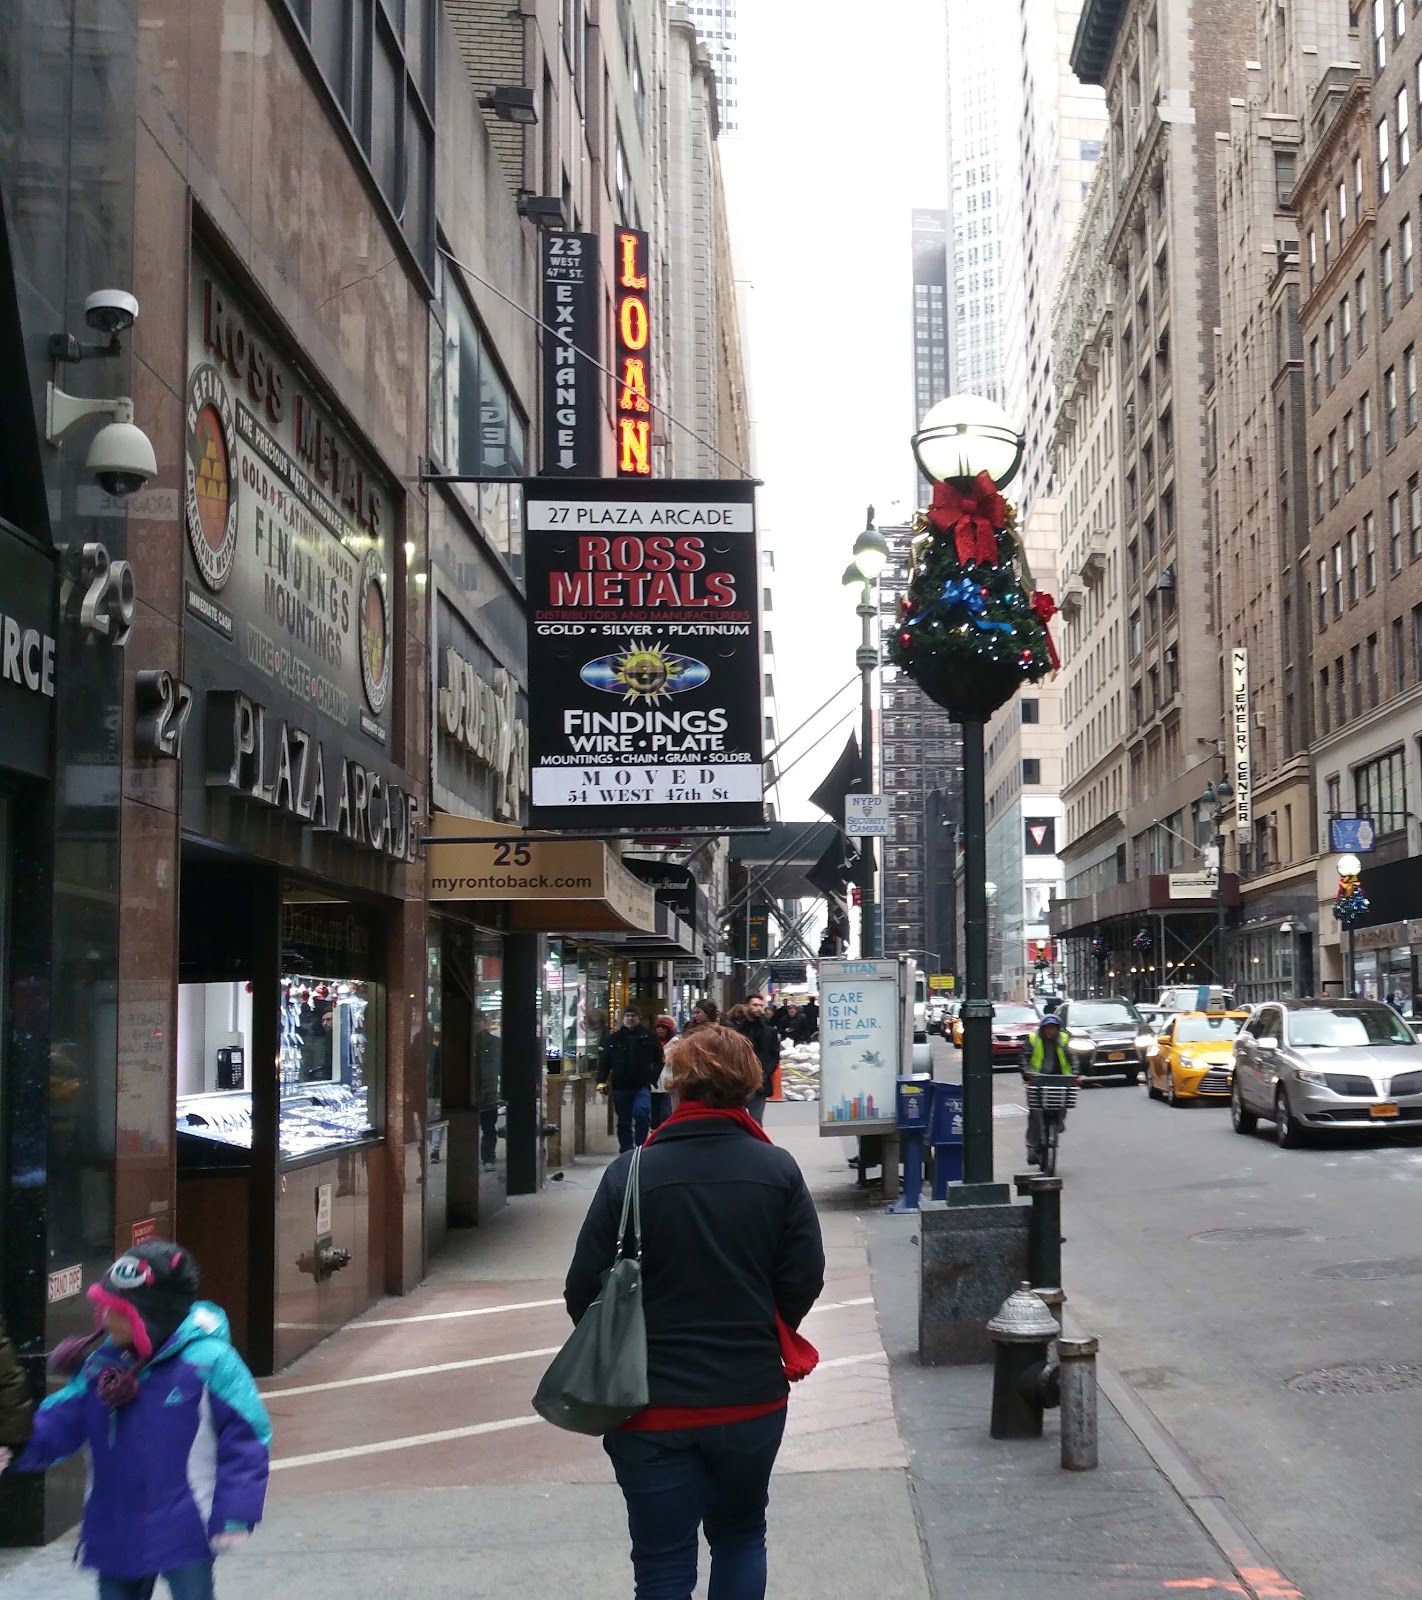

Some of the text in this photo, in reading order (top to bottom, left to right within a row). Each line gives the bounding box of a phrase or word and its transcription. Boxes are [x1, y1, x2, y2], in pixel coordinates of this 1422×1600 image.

[550, 238, 582, 255] 23
[550, 257, 580, 267] WEST
[555, 285, 577, 446] EXCHANGE
[620, 234, 650, 474] LOAN
[204, 278, 284, 424] ROSS
[296, 393, 381, 539] METALS
[239, 408, 253, 437] THE
[256, 427, 288, 477] PRECIOUS
[289, 463, 309, 498] METAL
[242, 456, 268, 501] GOLD
[277, 488, 320, 541] PLATINUM
[548, 507, 733, 525] 27 PLAZA ARCADE
[578, 536, 706, 572] ROSS
[255, 505, 350, 633] FINDINGS
[81, 542, 136, 648] 29
[549, 571, 737, 607] METALS
[189, 591, 232, 632] IMMEDIATE CASH
[264, 571, 343, 670] MOUNTINGS
[535, 610, 750, 621] DISTRIBUTORS AND MANUFACTURERS
[537, 625, 750, 636] GOLD SILVER PLATINUM
[0, 612, 56, 698] RCE
[247, 623, 274, 677] WIRE
[1234, 653, 1245, 676] NY
[150, 669, 193, 760] 27
[564, 708, 729, 735] FINDINGS
[1235, 684, 1246, 754] JEWELRY
[569, 734, 725, 752] WIRE PLATE
[541, 753, 752, 765] MOUNTINGS CHAIN GRAIN SOLDER
[227, 693, 328, 828] PLAZA
[336, 756, 418, 863] ARCADE
[582, 769, 715, 786] MOVED
[568, 788, 729, 803] 54 WEST 47th St
[852, 797, 882, 806] NYPD
[1238, 762, 1249, 822] CENTER
[847, 816, 886, 825] SECURITY
[849, 824, 886, 833] CAMERA
[492, 841, 532, 867] 25
[431, 874, 592, 892] myrontoback.com
[841, 963, 877, 973] TITAN
[827, 992, 863, 1004] CARE
[828, 1005, 858, 1017] IS IN
[828, 1018, 881, 1030] THE AIR.
